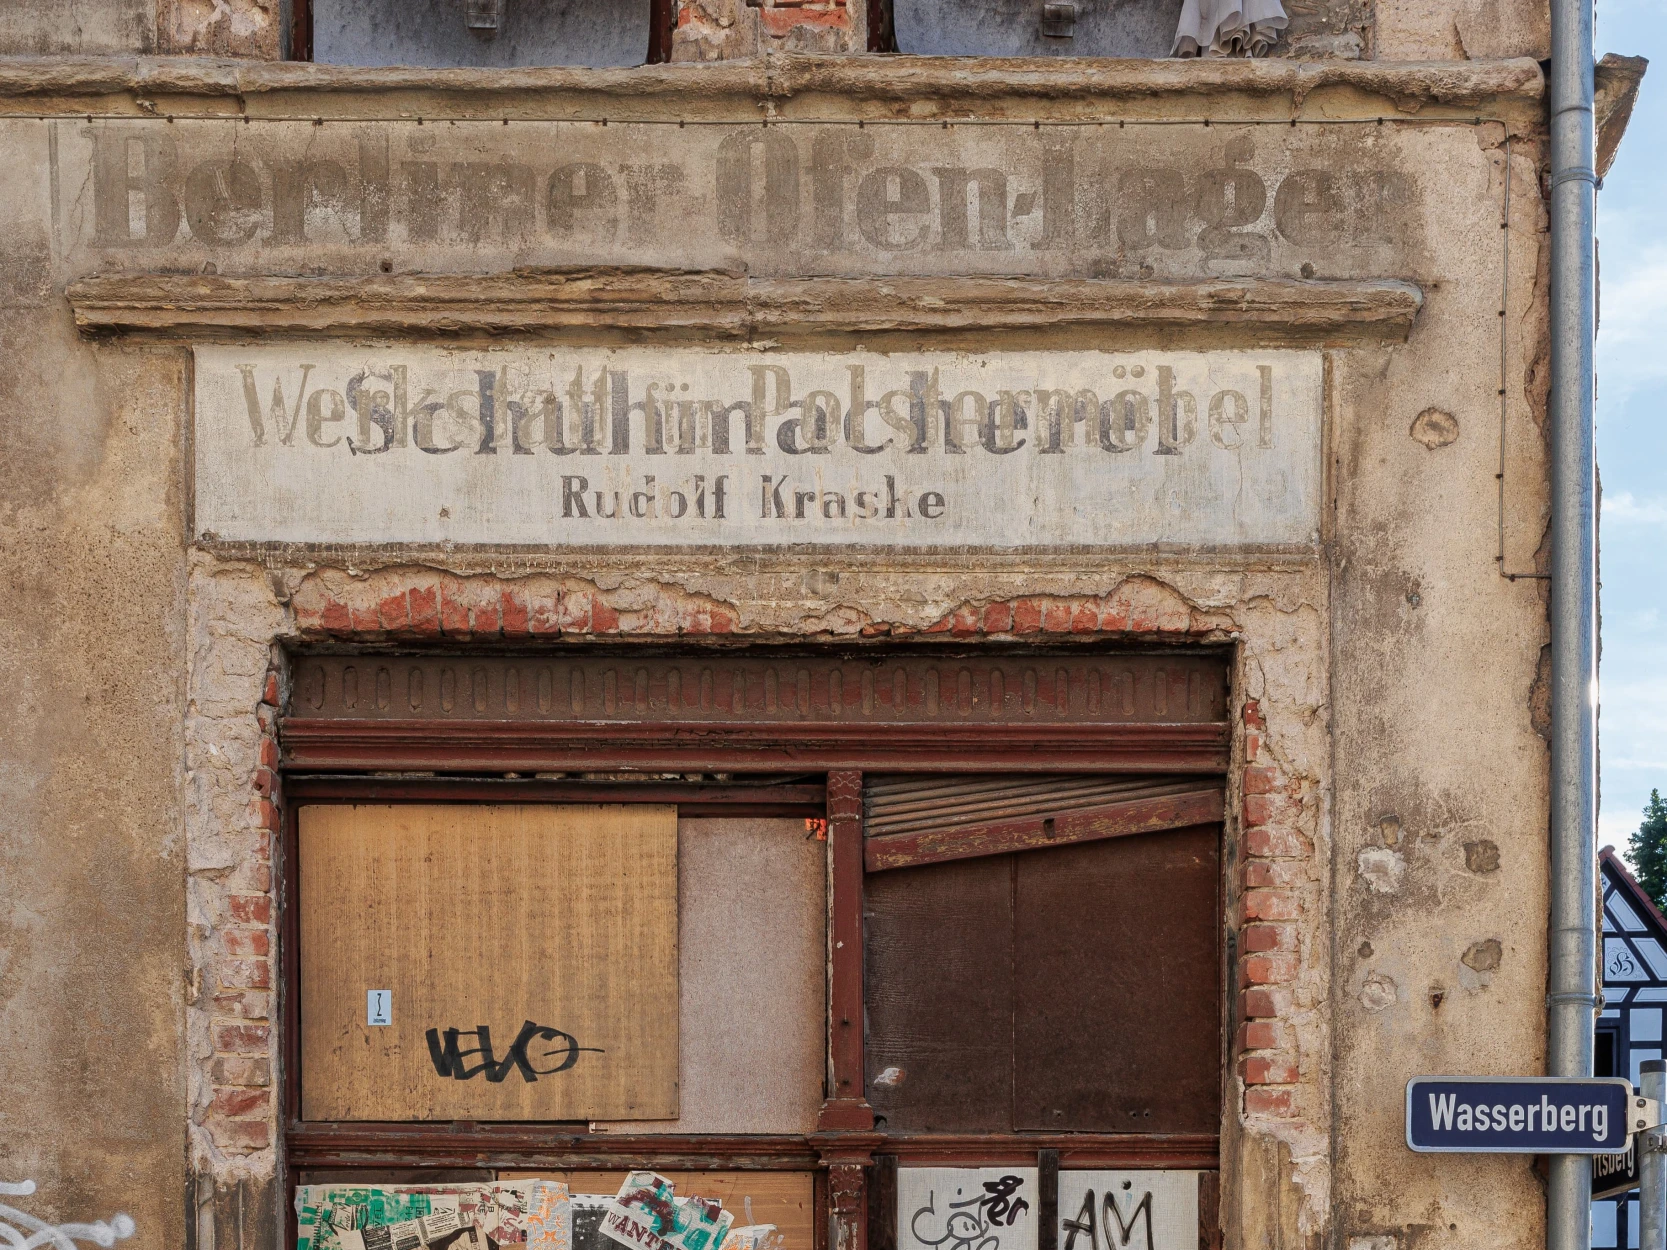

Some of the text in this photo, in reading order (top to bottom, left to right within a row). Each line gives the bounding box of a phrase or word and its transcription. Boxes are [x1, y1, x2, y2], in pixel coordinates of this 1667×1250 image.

[81, 126, 692, 248] Berliner
[746, 364, 1274, 450] Polstermöbel
[561, 475, 946, 520] Rudolf Kraske
[1429, 1093, 1608, 1142] Wasserberg
